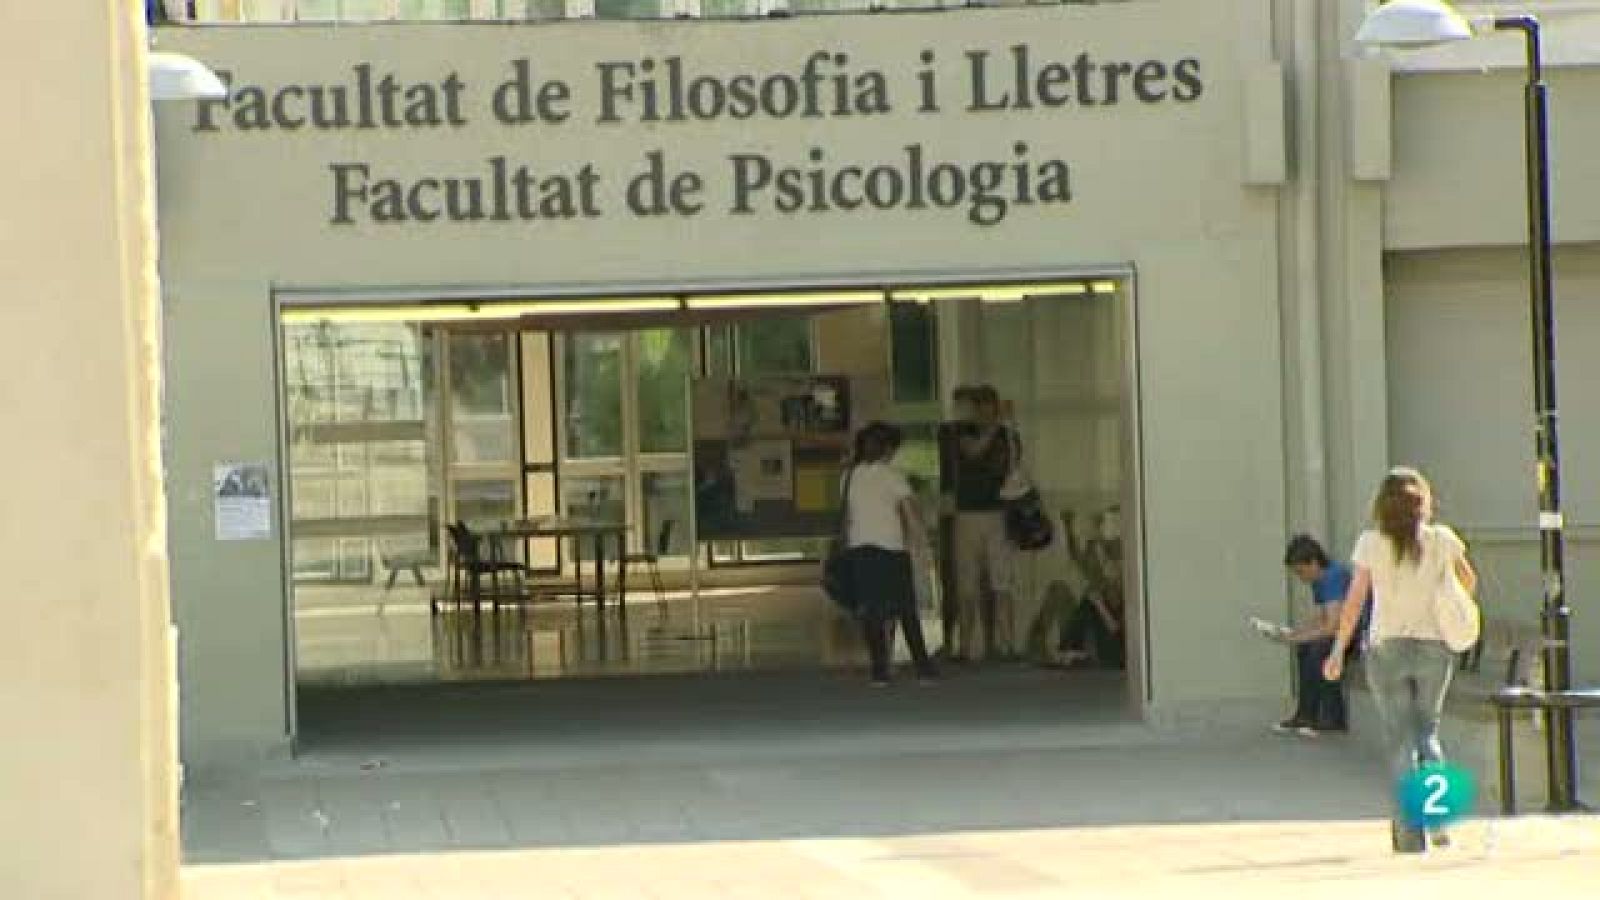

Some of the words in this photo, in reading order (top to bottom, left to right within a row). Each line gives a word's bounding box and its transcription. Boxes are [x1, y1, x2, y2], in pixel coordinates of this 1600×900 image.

[492, 59, 570, 126] de
[596, 51, 891, 126] Filosofia
[918, 49, 941, 113] i
[964, 43, 1203, 112] Lletres
[329, 156, 602, 226] Facultat
[626, 148, 704, 216] de
[728, 142, 1072, 226] Psicologia
